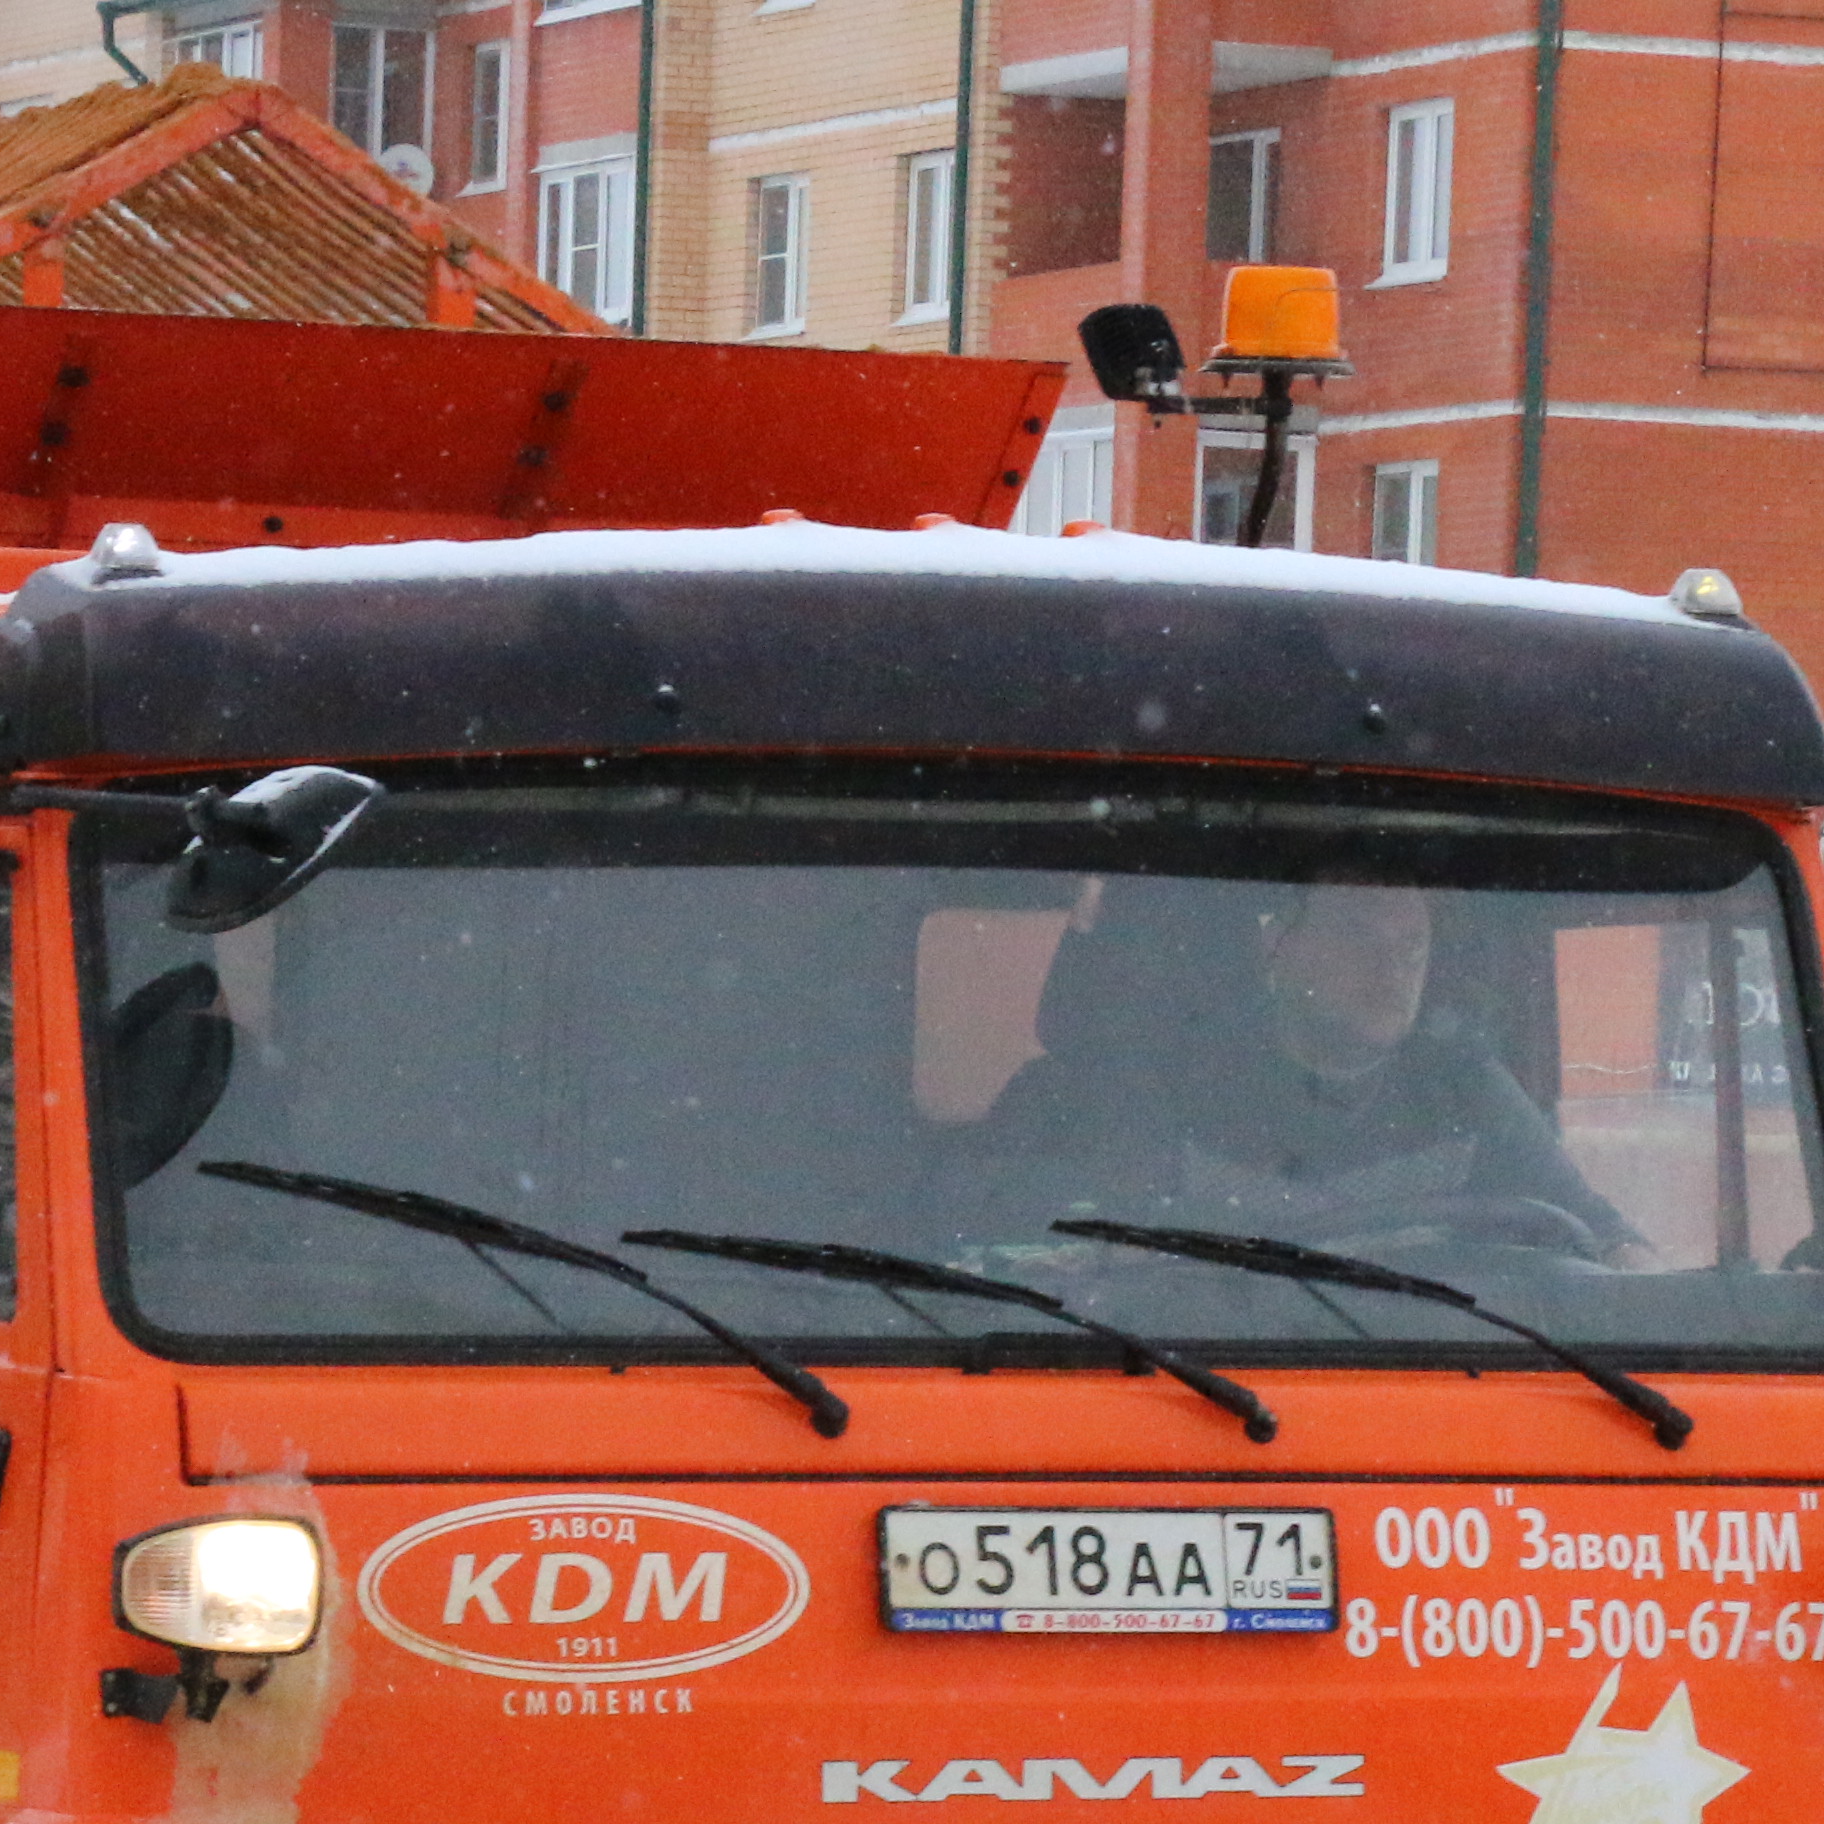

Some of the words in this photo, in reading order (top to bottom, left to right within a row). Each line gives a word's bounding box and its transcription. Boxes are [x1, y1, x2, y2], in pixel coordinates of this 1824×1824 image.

[529, 1517, 637, 1544] ЗАВОД
[1375, 1506, 1492, 1570] ООО
[1494, 1488, 1664, 1580] "Завод
[1675, 1492, 1819, 1584] КДМ"
[1234, 1522, 1304, 1577] 71
[442, 1551, 729, 1626] KDM
[1233, 1579, 1284, 1600] RUS
[1042, 1613, 1216, 1630] 8-800-500-67-67
[555, 1636, 618, 1659] 1911
[502, 1688, 695, 1716] СМОЛЕНСК
[821, 1754, 1366, 1804] KAMAZ
